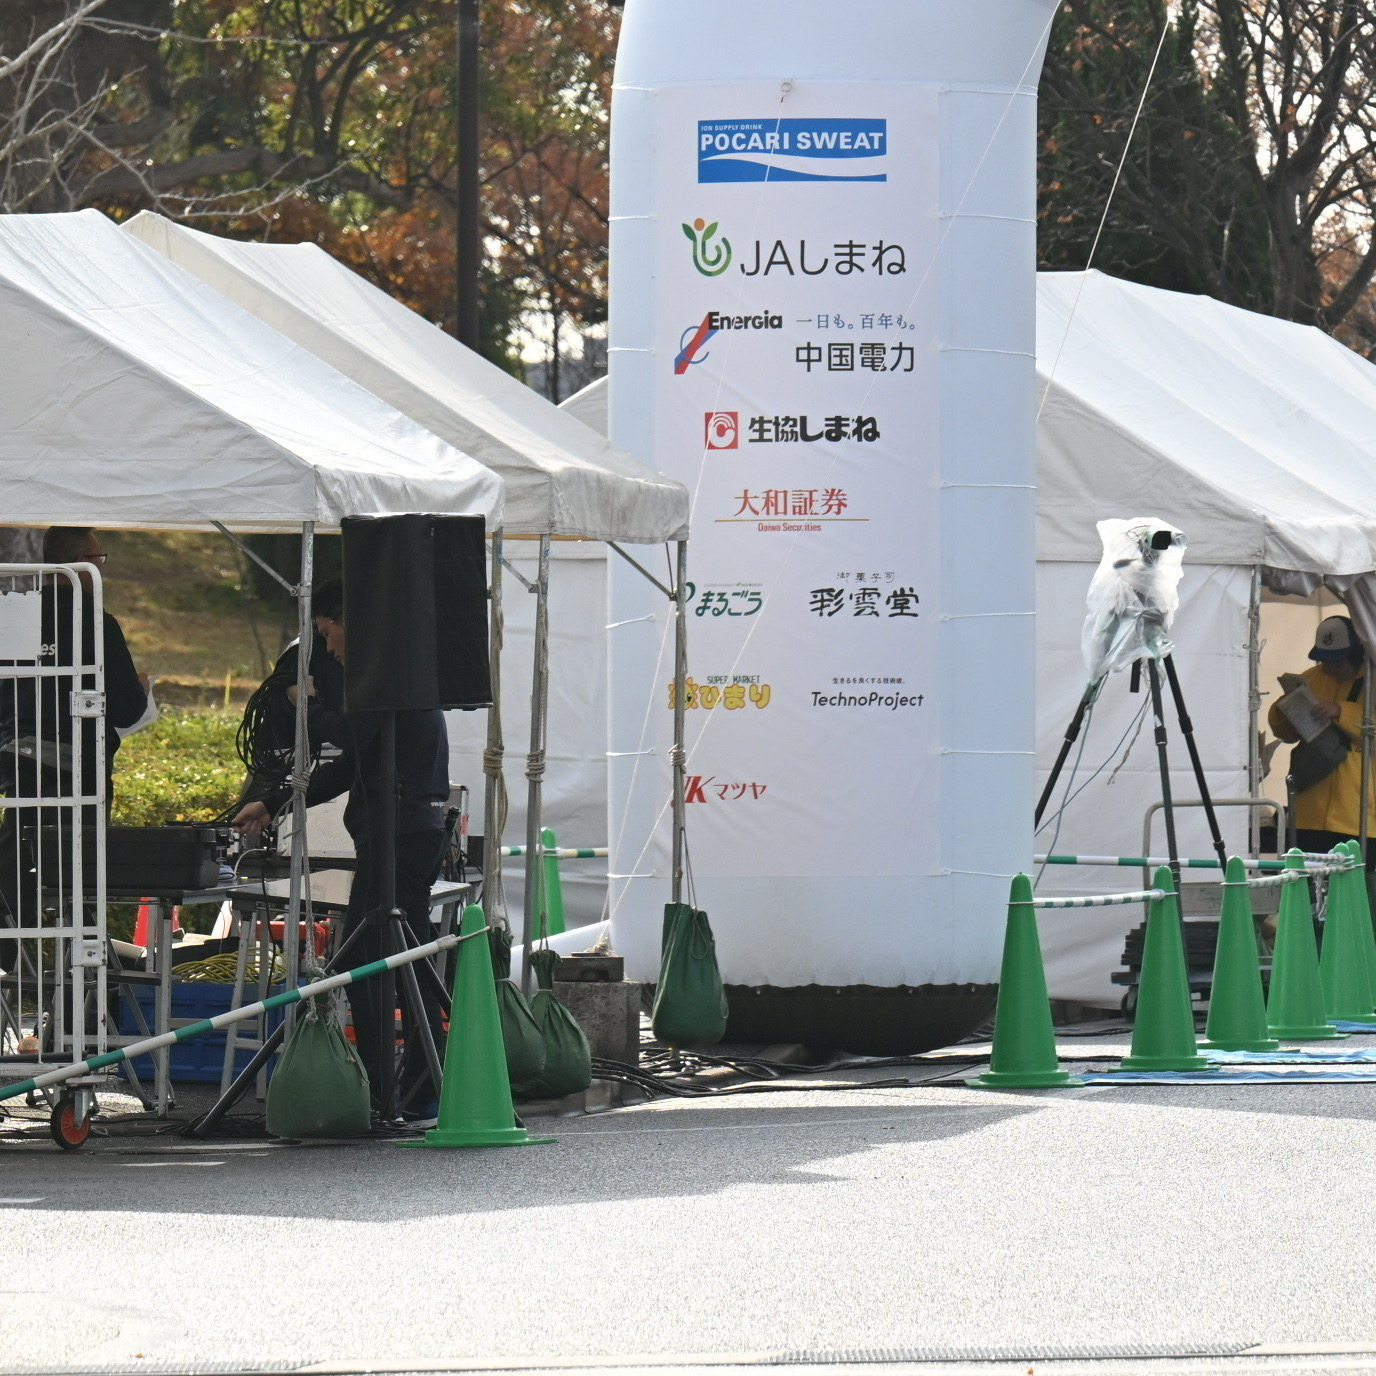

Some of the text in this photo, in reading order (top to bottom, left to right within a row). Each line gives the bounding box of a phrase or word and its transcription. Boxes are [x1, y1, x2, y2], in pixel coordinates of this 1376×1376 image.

[701, 132, 883, 151] POCARI SWEAT
[740, 239, 907, 276] JAしまね
[795, 341, 915, 373] 中国電力
[748, 415, 880, 444] 生協しまね
[733, 487, 848, 517] 大和証券
[757, 523, 781, 532] Daiwa
[695, 590, 763, 618] まるごう
[809, 587, 920, 618] 彩雲堂
[733, 675, 761, 684] MARKET
[811, 691, 924, 710] TechnoProject
[714, 782, 767, 800] マツヤ
